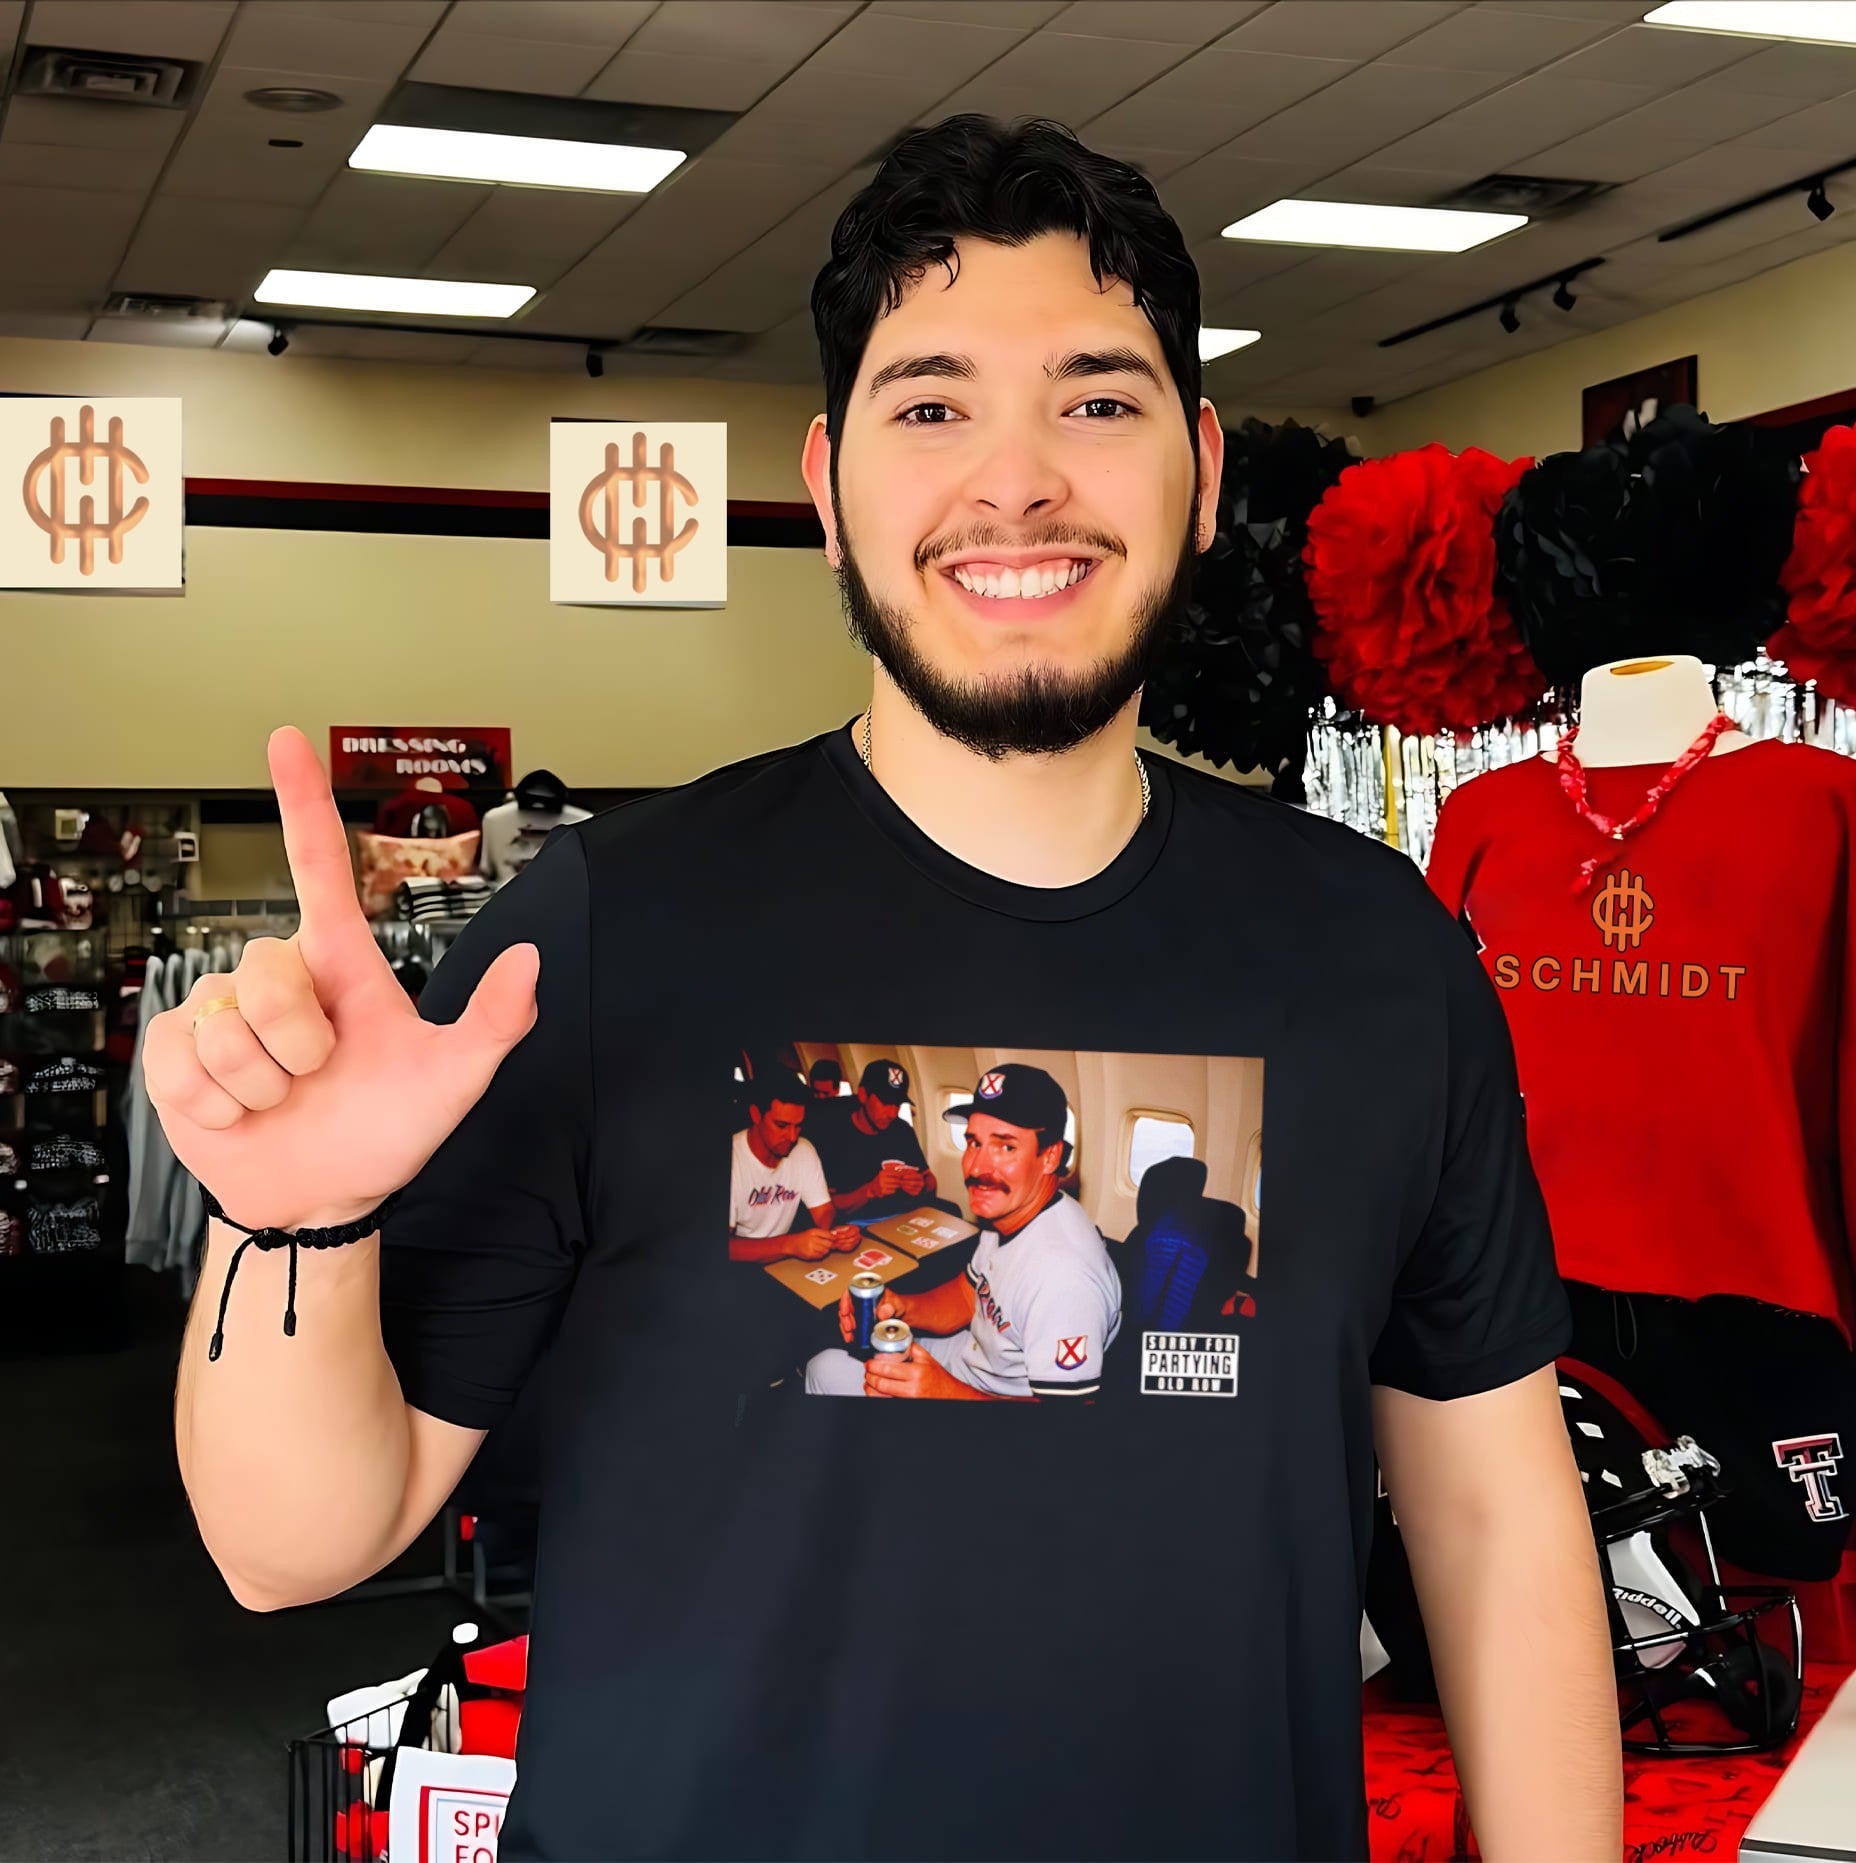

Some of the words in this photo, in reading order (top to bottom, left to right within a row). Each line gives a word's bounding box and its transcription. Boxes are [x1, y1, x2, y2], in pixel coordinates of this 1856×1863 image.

[396, 758, 486, 775] ROOMS
[1494, 953, 1747, 1000] SCHMIDT
[1148, 1335, 1198, 1351] SORRY
[1205, 1337, 1233, 1352] FOR
[1148, 1353, 1232, 1375] PARTYING
[1157, 1377, 1184, 1391] OLD
[1191, 1378, 1221, 1392] ROW
